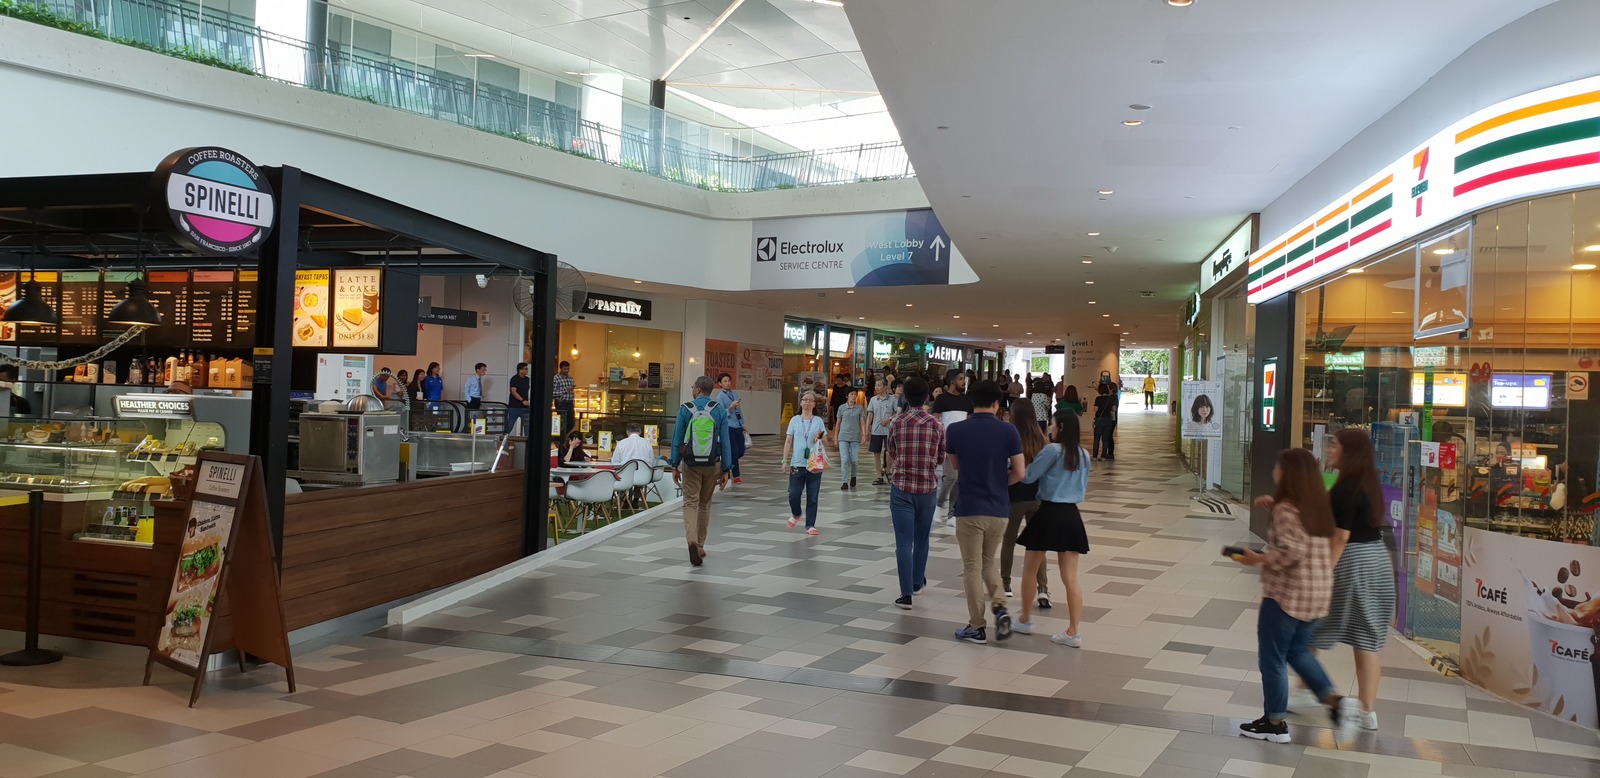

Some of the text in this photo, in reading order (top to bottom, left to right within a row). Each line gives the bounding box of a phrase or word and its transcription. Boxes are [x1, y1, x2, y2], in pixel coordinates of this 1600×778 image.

[188, 150, 259, 180] COFFEE ROASTERS
[184, 182, 259, 220] SPINELLI
[780, 240, 844, 255] Electrolux
[870, 238, 925, 249] West Lobby
[880, 251, 914, 262] Level 7
[780, 260, 844, 271] SERVICE CENTRE
[313, 273, 329, 281] TAPAS
[349, 285, 376, 293] CAKE
[706, 350, 735, 368] TOASTED
[120, 400, 190, 410] HEALTHIER CHOICES
[209, 466, 237, 481] SPINELLI
